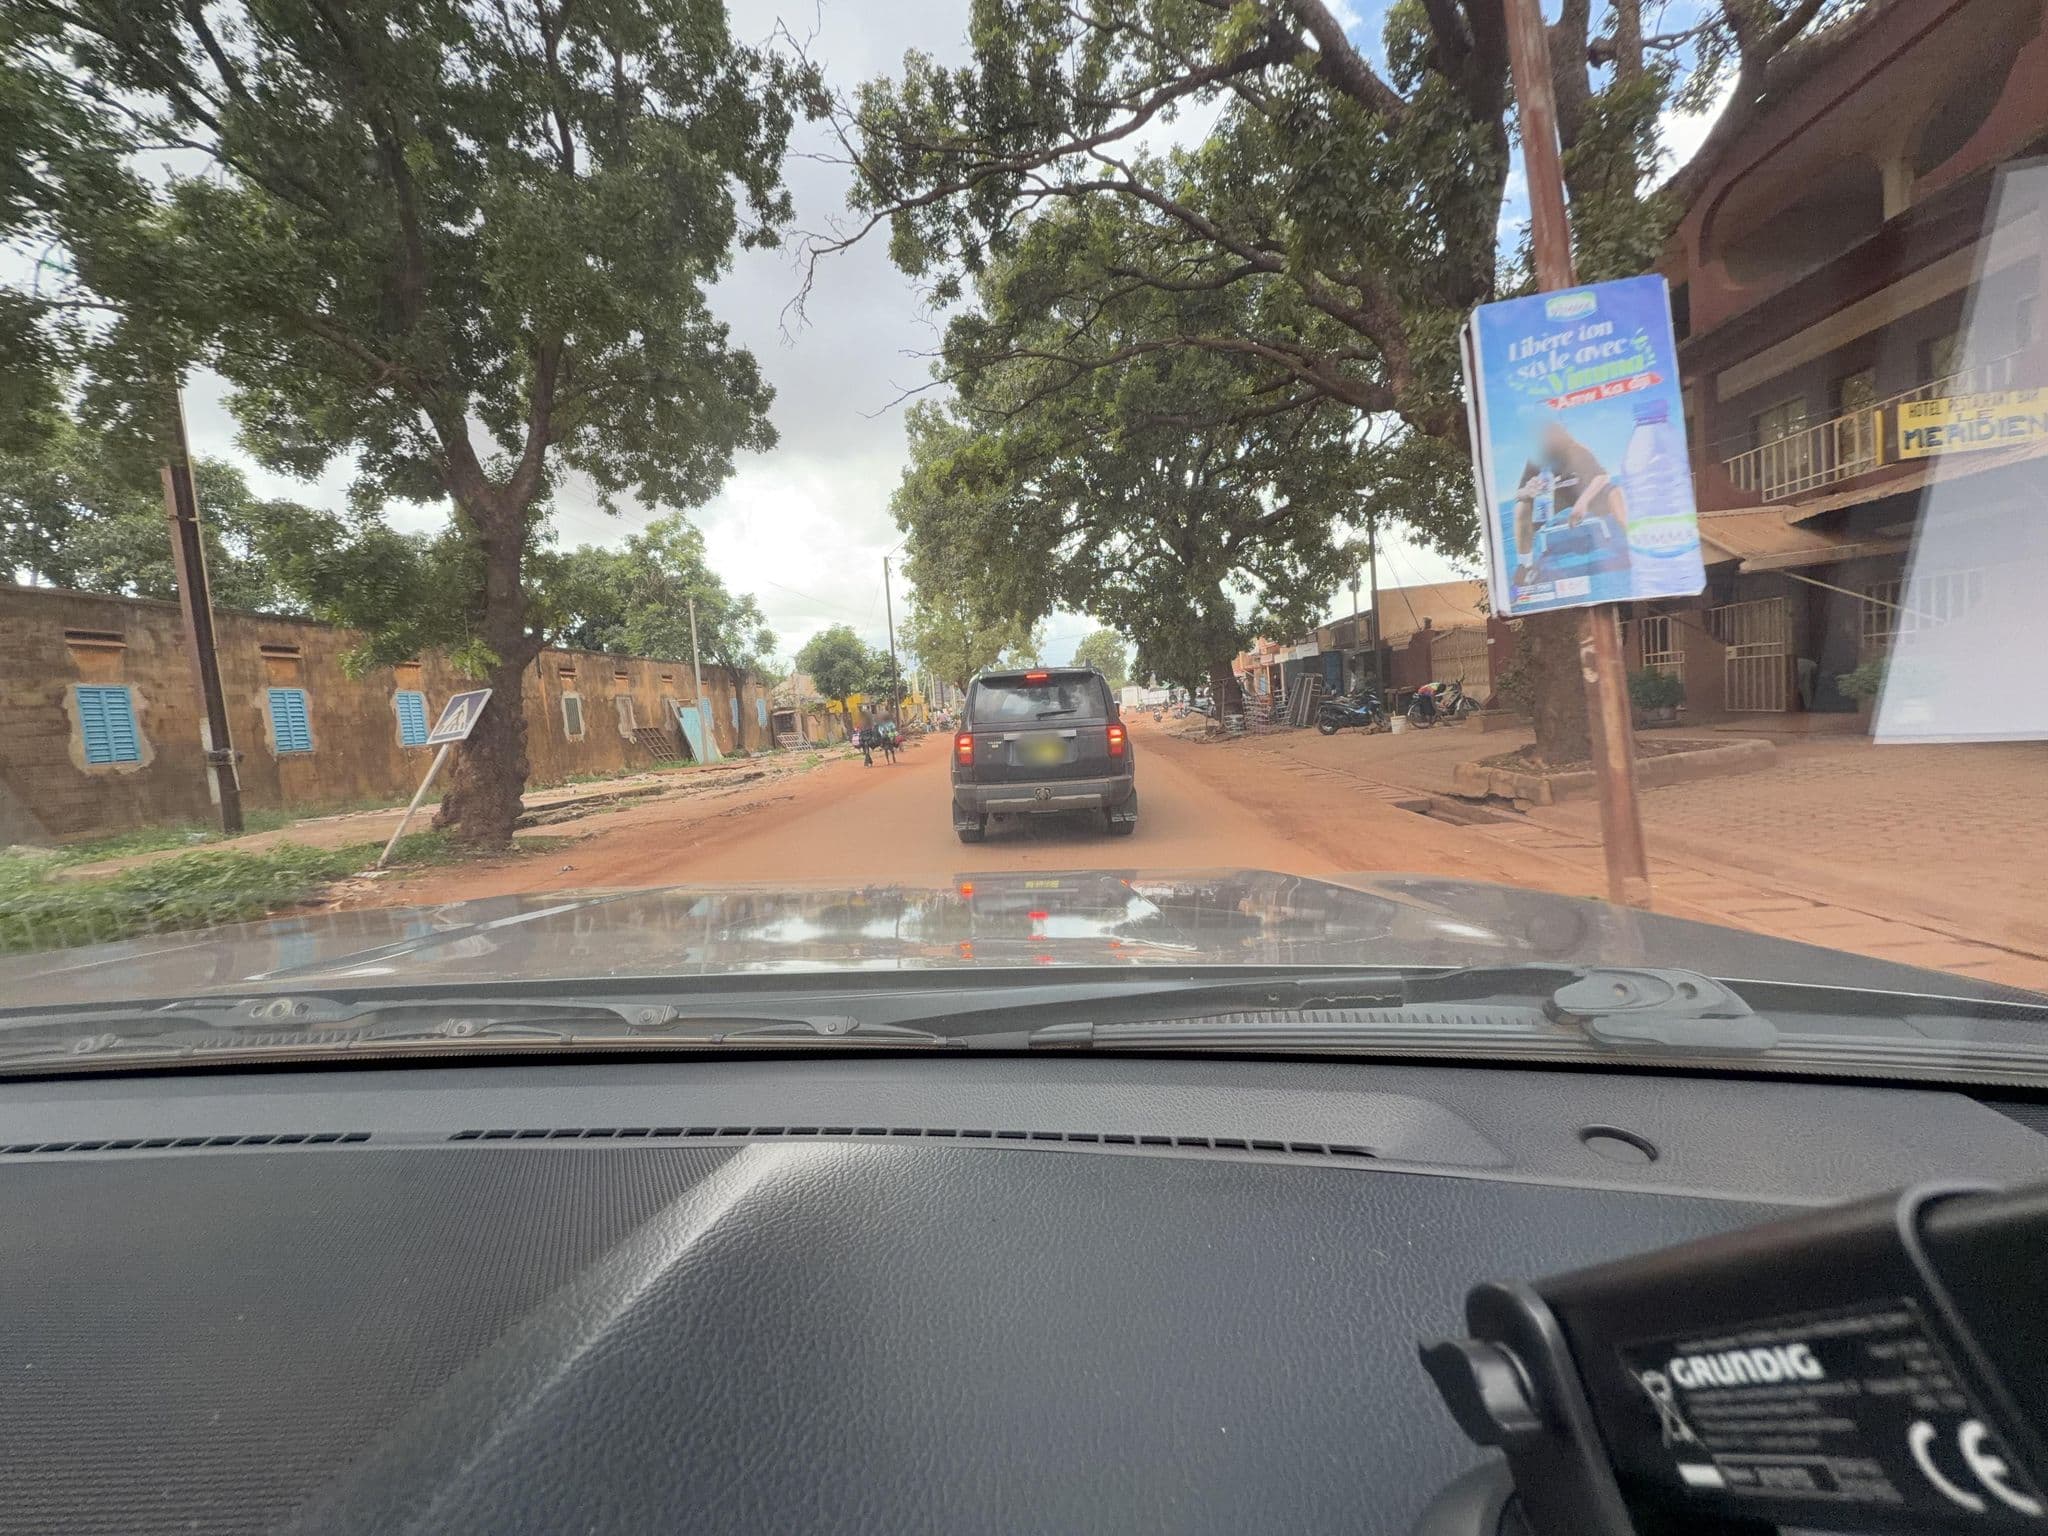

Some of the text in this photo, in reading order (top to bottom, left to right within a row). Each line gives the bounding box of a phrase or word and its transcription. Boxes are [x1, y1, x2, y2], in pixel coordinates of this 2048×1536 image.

[1575, 338, 1627, 363] avec
[1909, 400, 1942, 418] HOTEL
[1669, 1342, 1825, 1390] GRUNDIG
